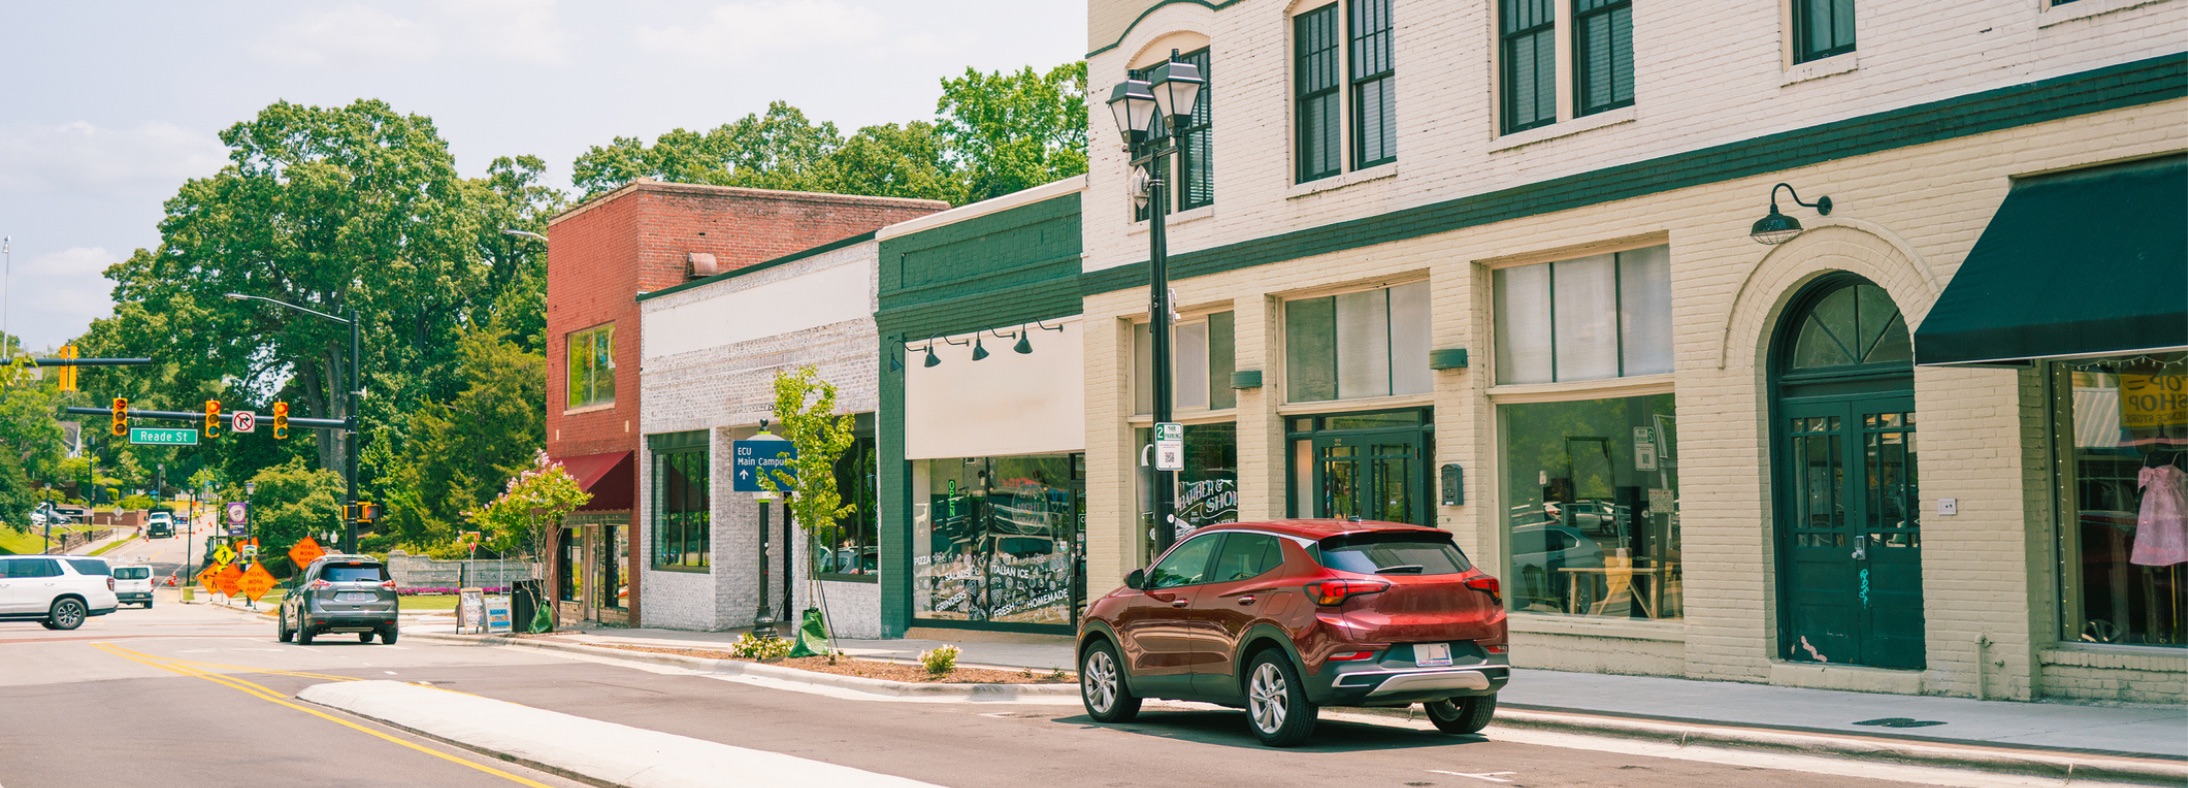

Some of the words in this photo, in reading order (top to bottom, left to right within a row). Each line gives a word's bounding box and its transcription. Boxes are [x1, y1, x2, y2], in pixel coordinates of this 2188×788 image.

[140, 430, 172, 442] Reade
[176, 432, 188, 442] St
[1157, 426, 1164, 438] 2
[738, 447, 752, 456] ECU
[738, 456, 756, 466] Main
[758, 457, 786, 467] Campu
[1178, 480, 1214, 512] BARBER
[914, 556, 931, 565] PIZZA
[945, 570, 970, 582] SALADS
[990, 564, 1016, 576] ITALIAN
[1017, 568, 1029, 578] ICE
[936, 592, 967, 612] GRINDERS
[994, 602, 1014, 618] FRESH
[1026, 588, 1068, 608] HOMEMADE
